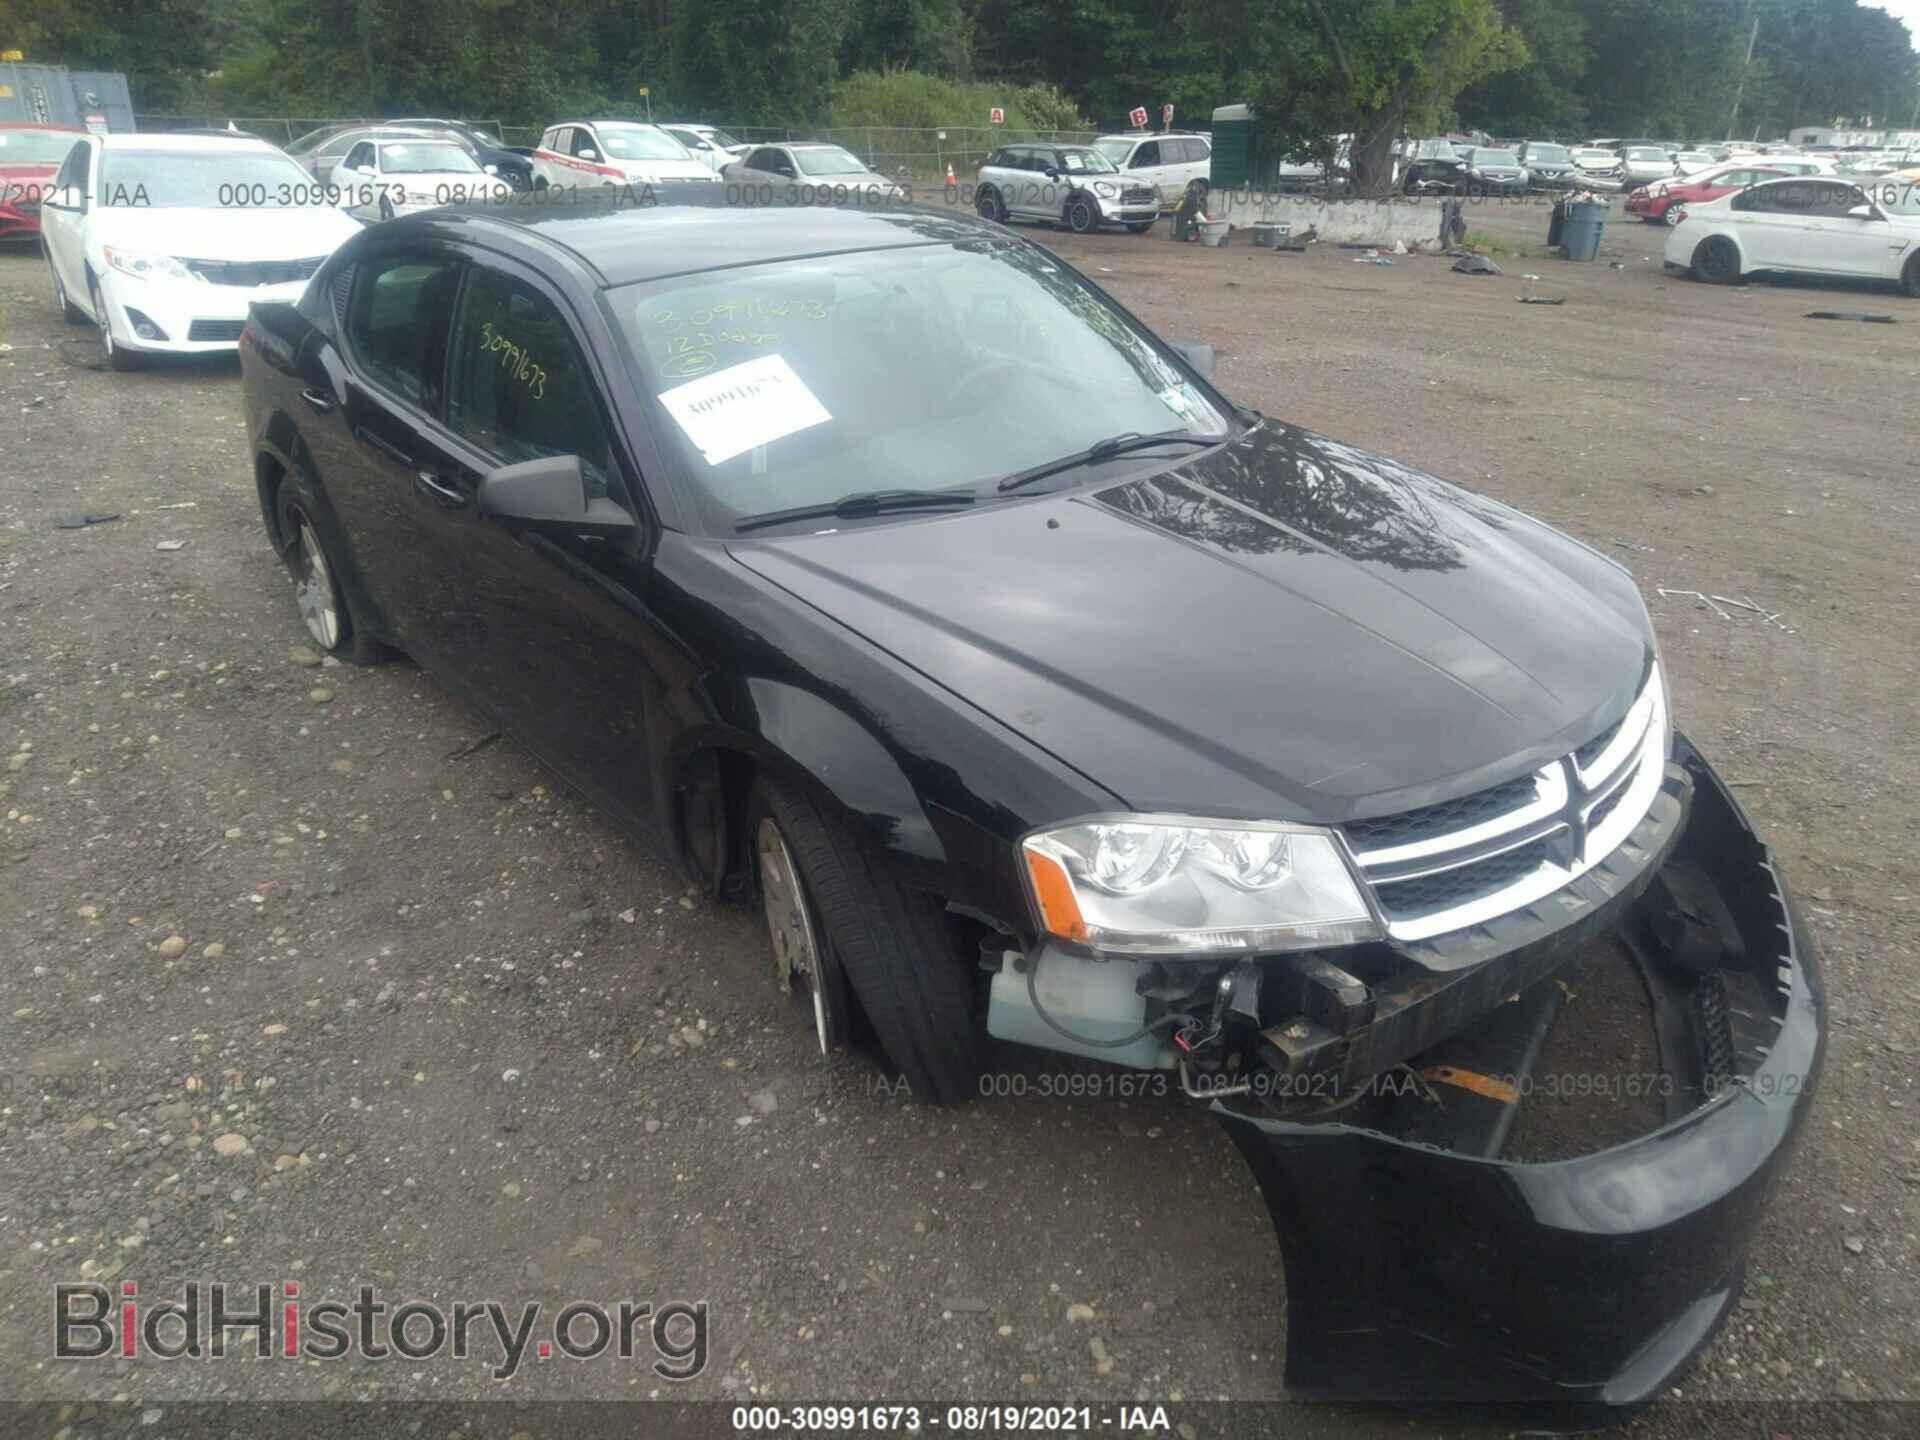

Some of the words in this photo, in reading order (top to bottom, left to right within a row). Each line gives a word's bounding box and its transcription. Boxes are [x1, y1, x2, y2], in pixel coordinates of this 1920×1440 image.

[992, 109, 1002, 123] A
[1132, 110, 1146, 125] B
[479, 321, 547, 400] 30991673
